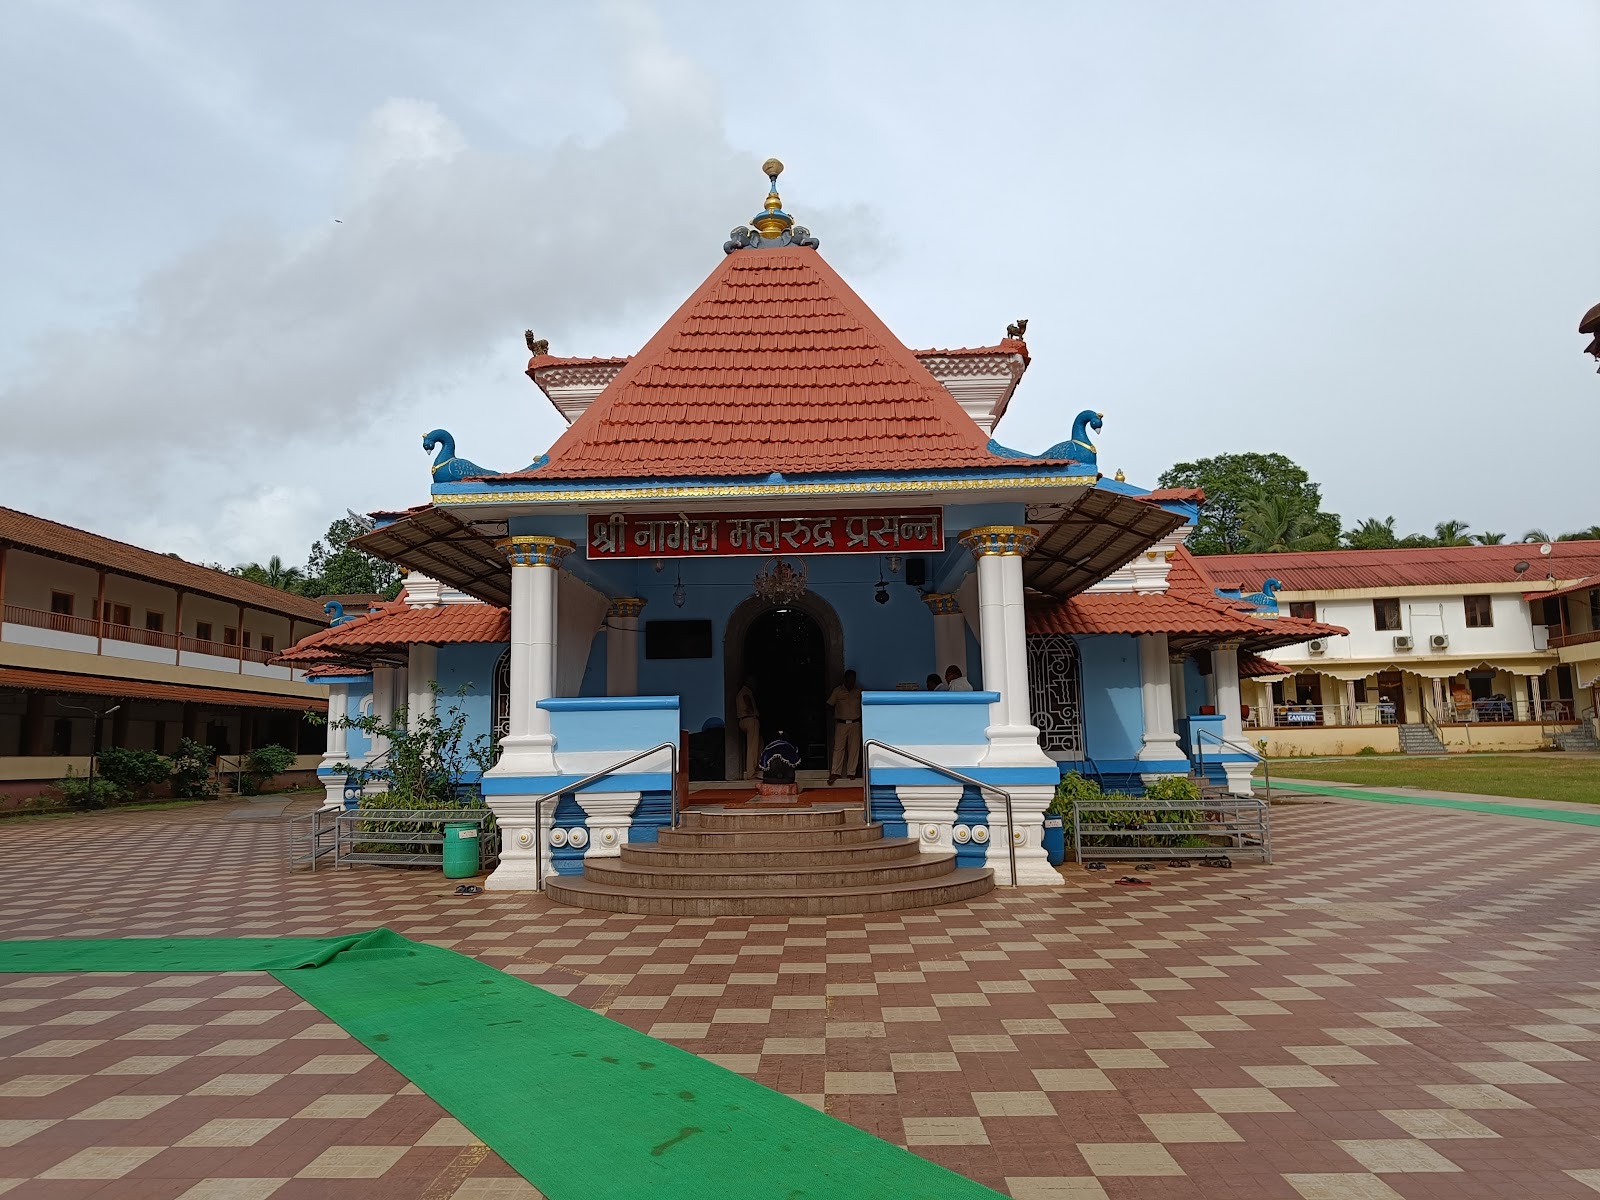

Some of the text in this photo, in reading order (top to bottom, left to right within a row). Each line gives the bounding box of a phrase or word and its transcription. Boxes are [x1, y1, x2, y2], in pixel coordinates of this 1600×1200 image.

[591, 512, 941, 553] श्री नागेश महारुद्र प्रसन्न
